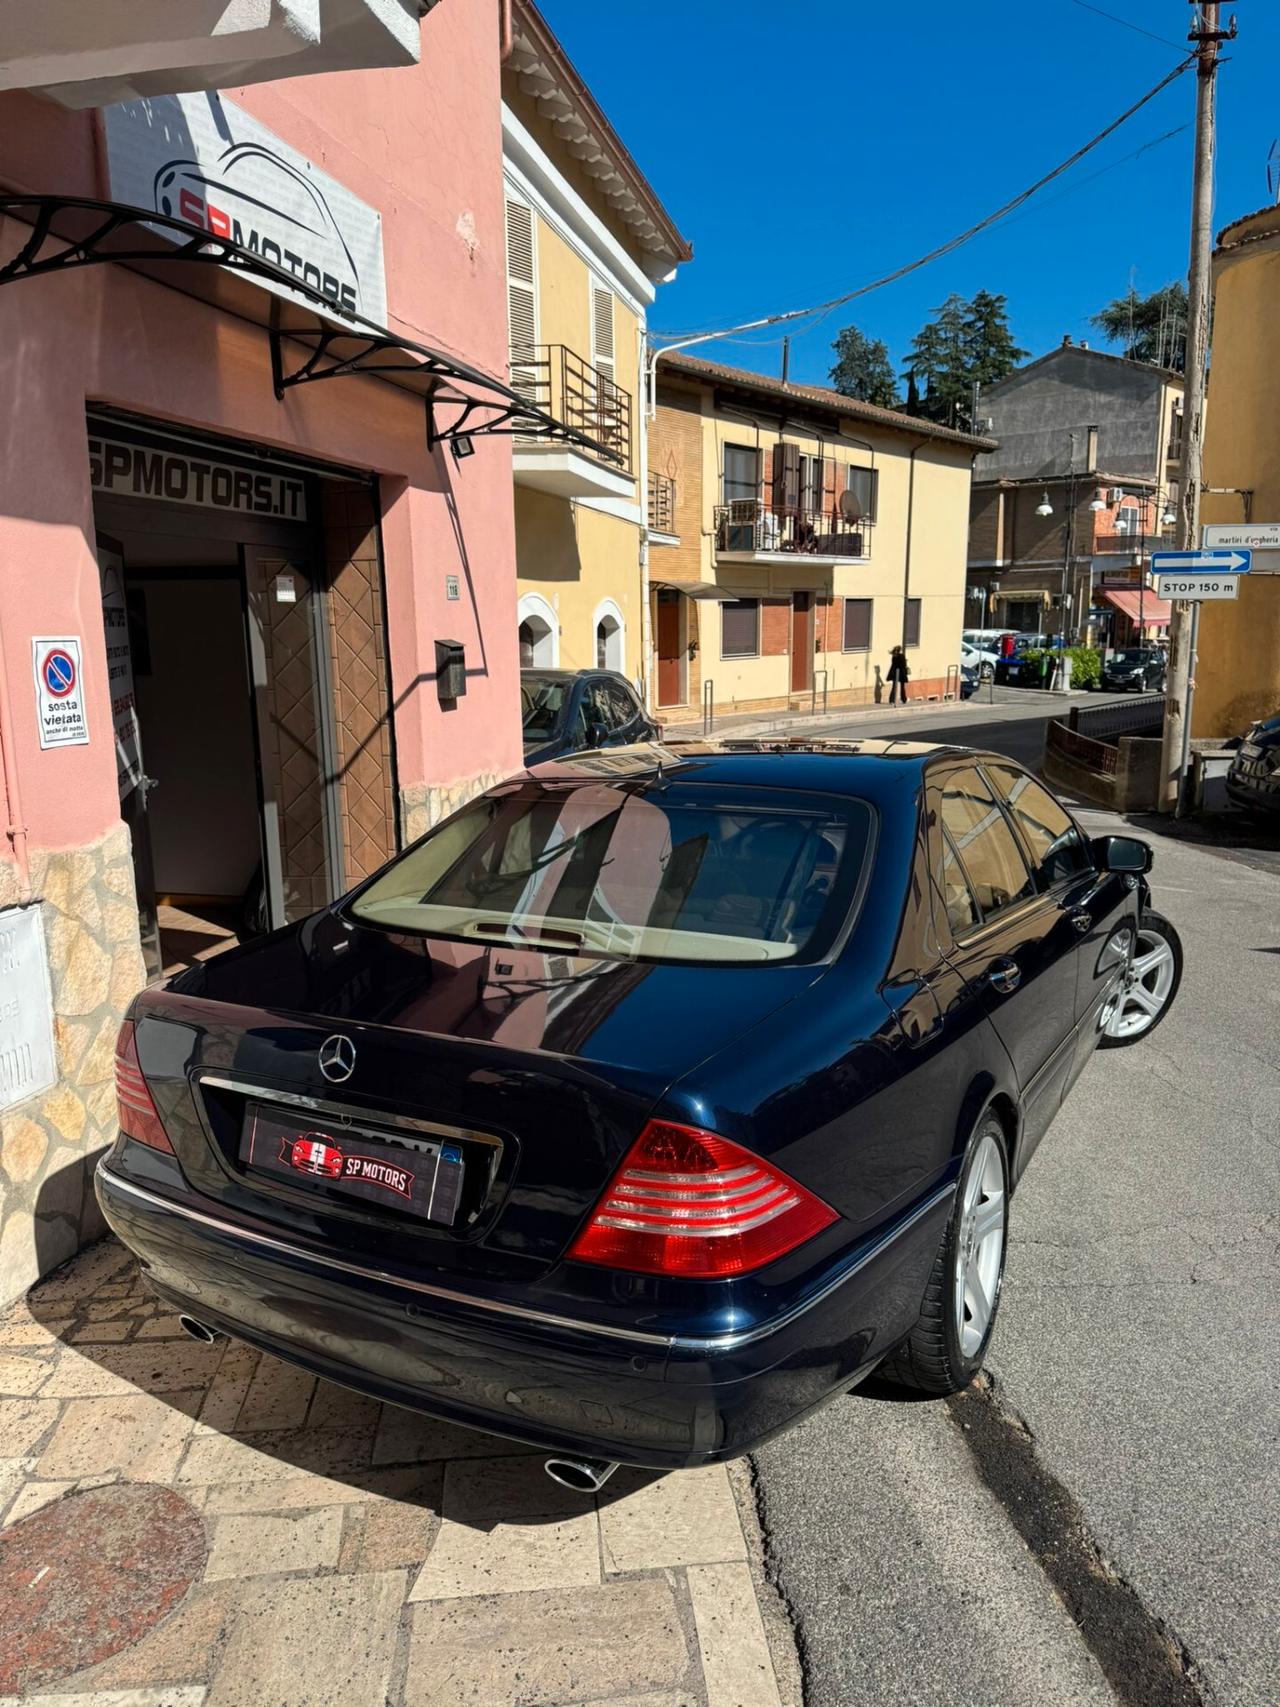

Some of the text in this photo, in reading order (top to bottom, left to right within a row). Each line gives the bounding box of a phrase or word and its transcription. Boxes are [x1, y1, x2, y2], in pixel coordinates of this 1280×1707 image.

[88, 439, 303, 518] SPMOTORS.IT
[1218, 536, 1242, 544] martiri
[1163, 583, 1196, 592] STOP
[1200, 583, 1219, 591] 150
[48, 700, 77, 711] sosta
[44, 713, 81, 725] vietata
[346, 1158, 407, 1191] SP MOTORS
